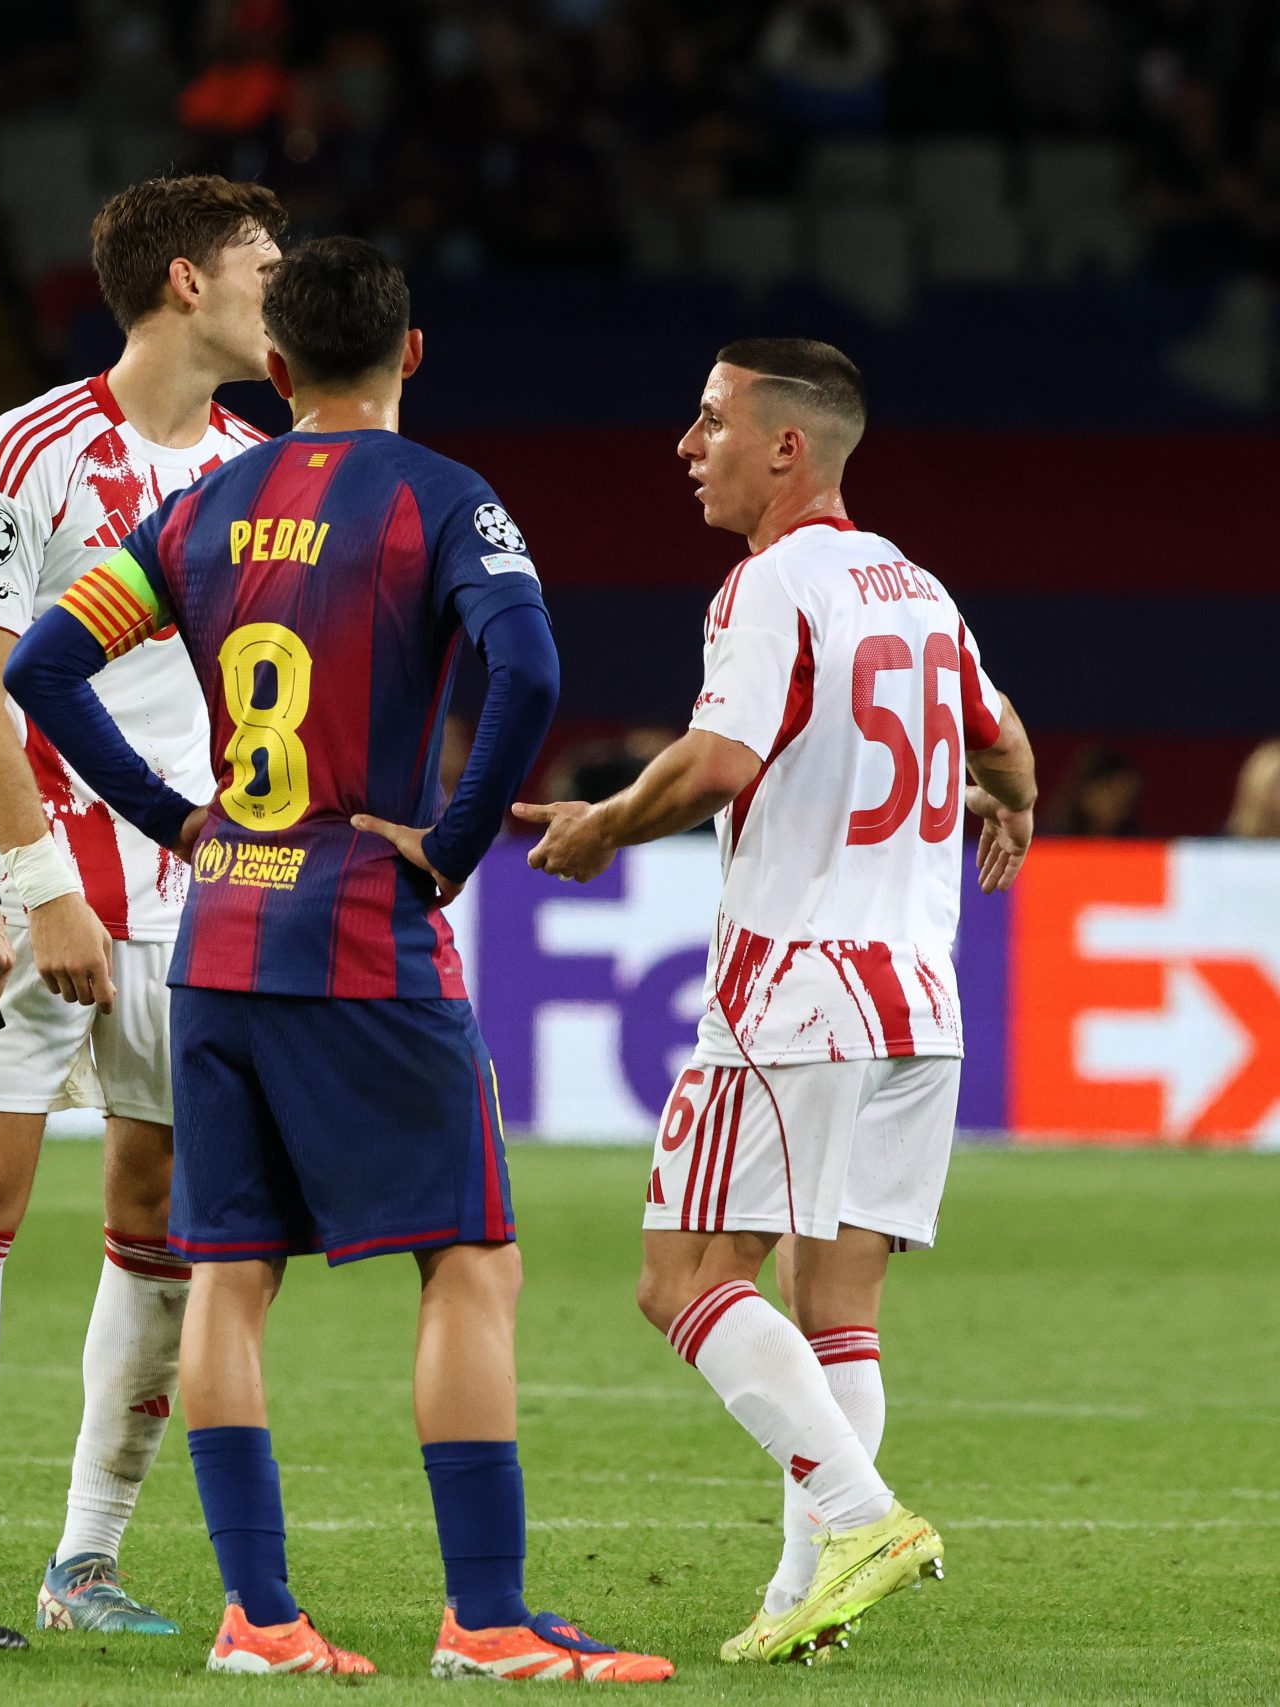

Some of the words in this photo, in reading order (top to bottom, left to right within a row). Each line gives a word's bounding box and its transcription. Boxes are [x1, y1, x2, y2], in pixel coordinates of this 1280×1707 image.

[230, 518, 330, 566] PEDRI
[218, 622, 313, 832] 8
[846, 632, 960, 846] 56
[229, 860, 300, 883] ACNUR
[236, 843, 306, 866] UNHCR
